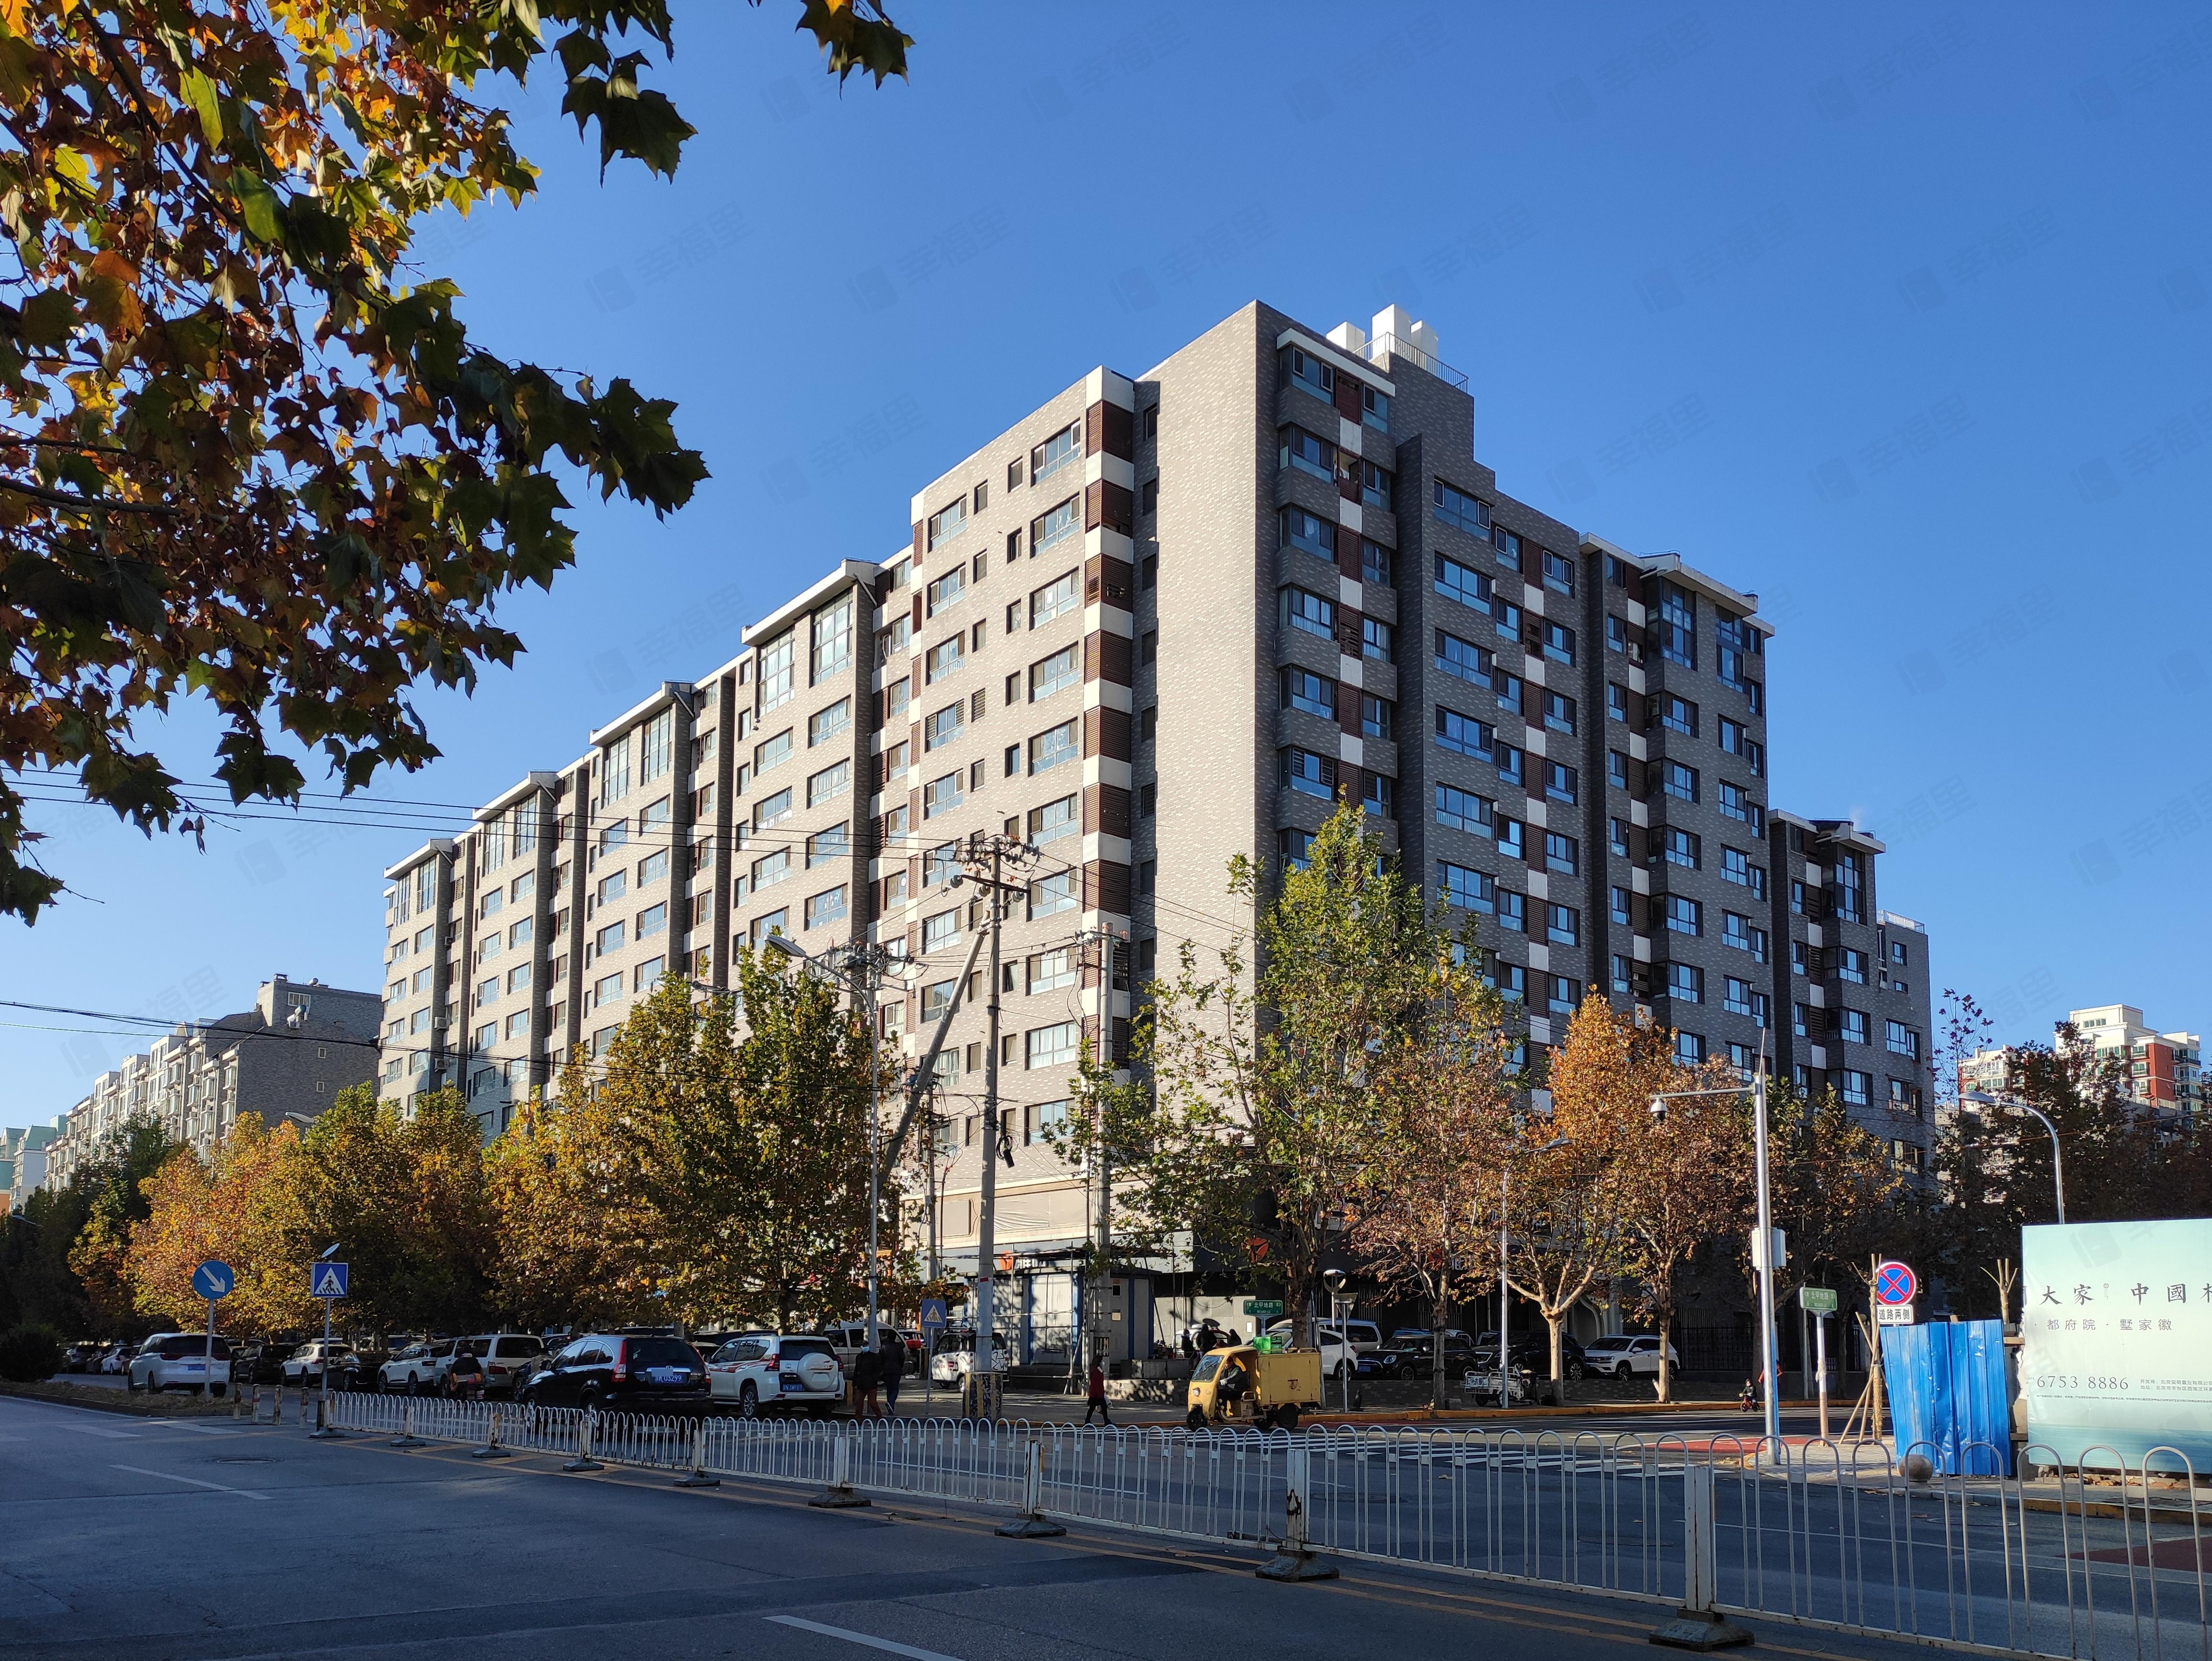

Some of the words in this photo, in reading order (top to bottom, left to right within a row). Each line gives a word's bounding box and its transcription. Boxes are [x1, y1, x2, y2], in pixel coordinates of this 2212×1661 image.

[1879, 1308, 1910, 1320] 道路两侧
[2037, 1375, 2078, 1388] 6753
[2088, 1376, 2128, 1390] 8886
